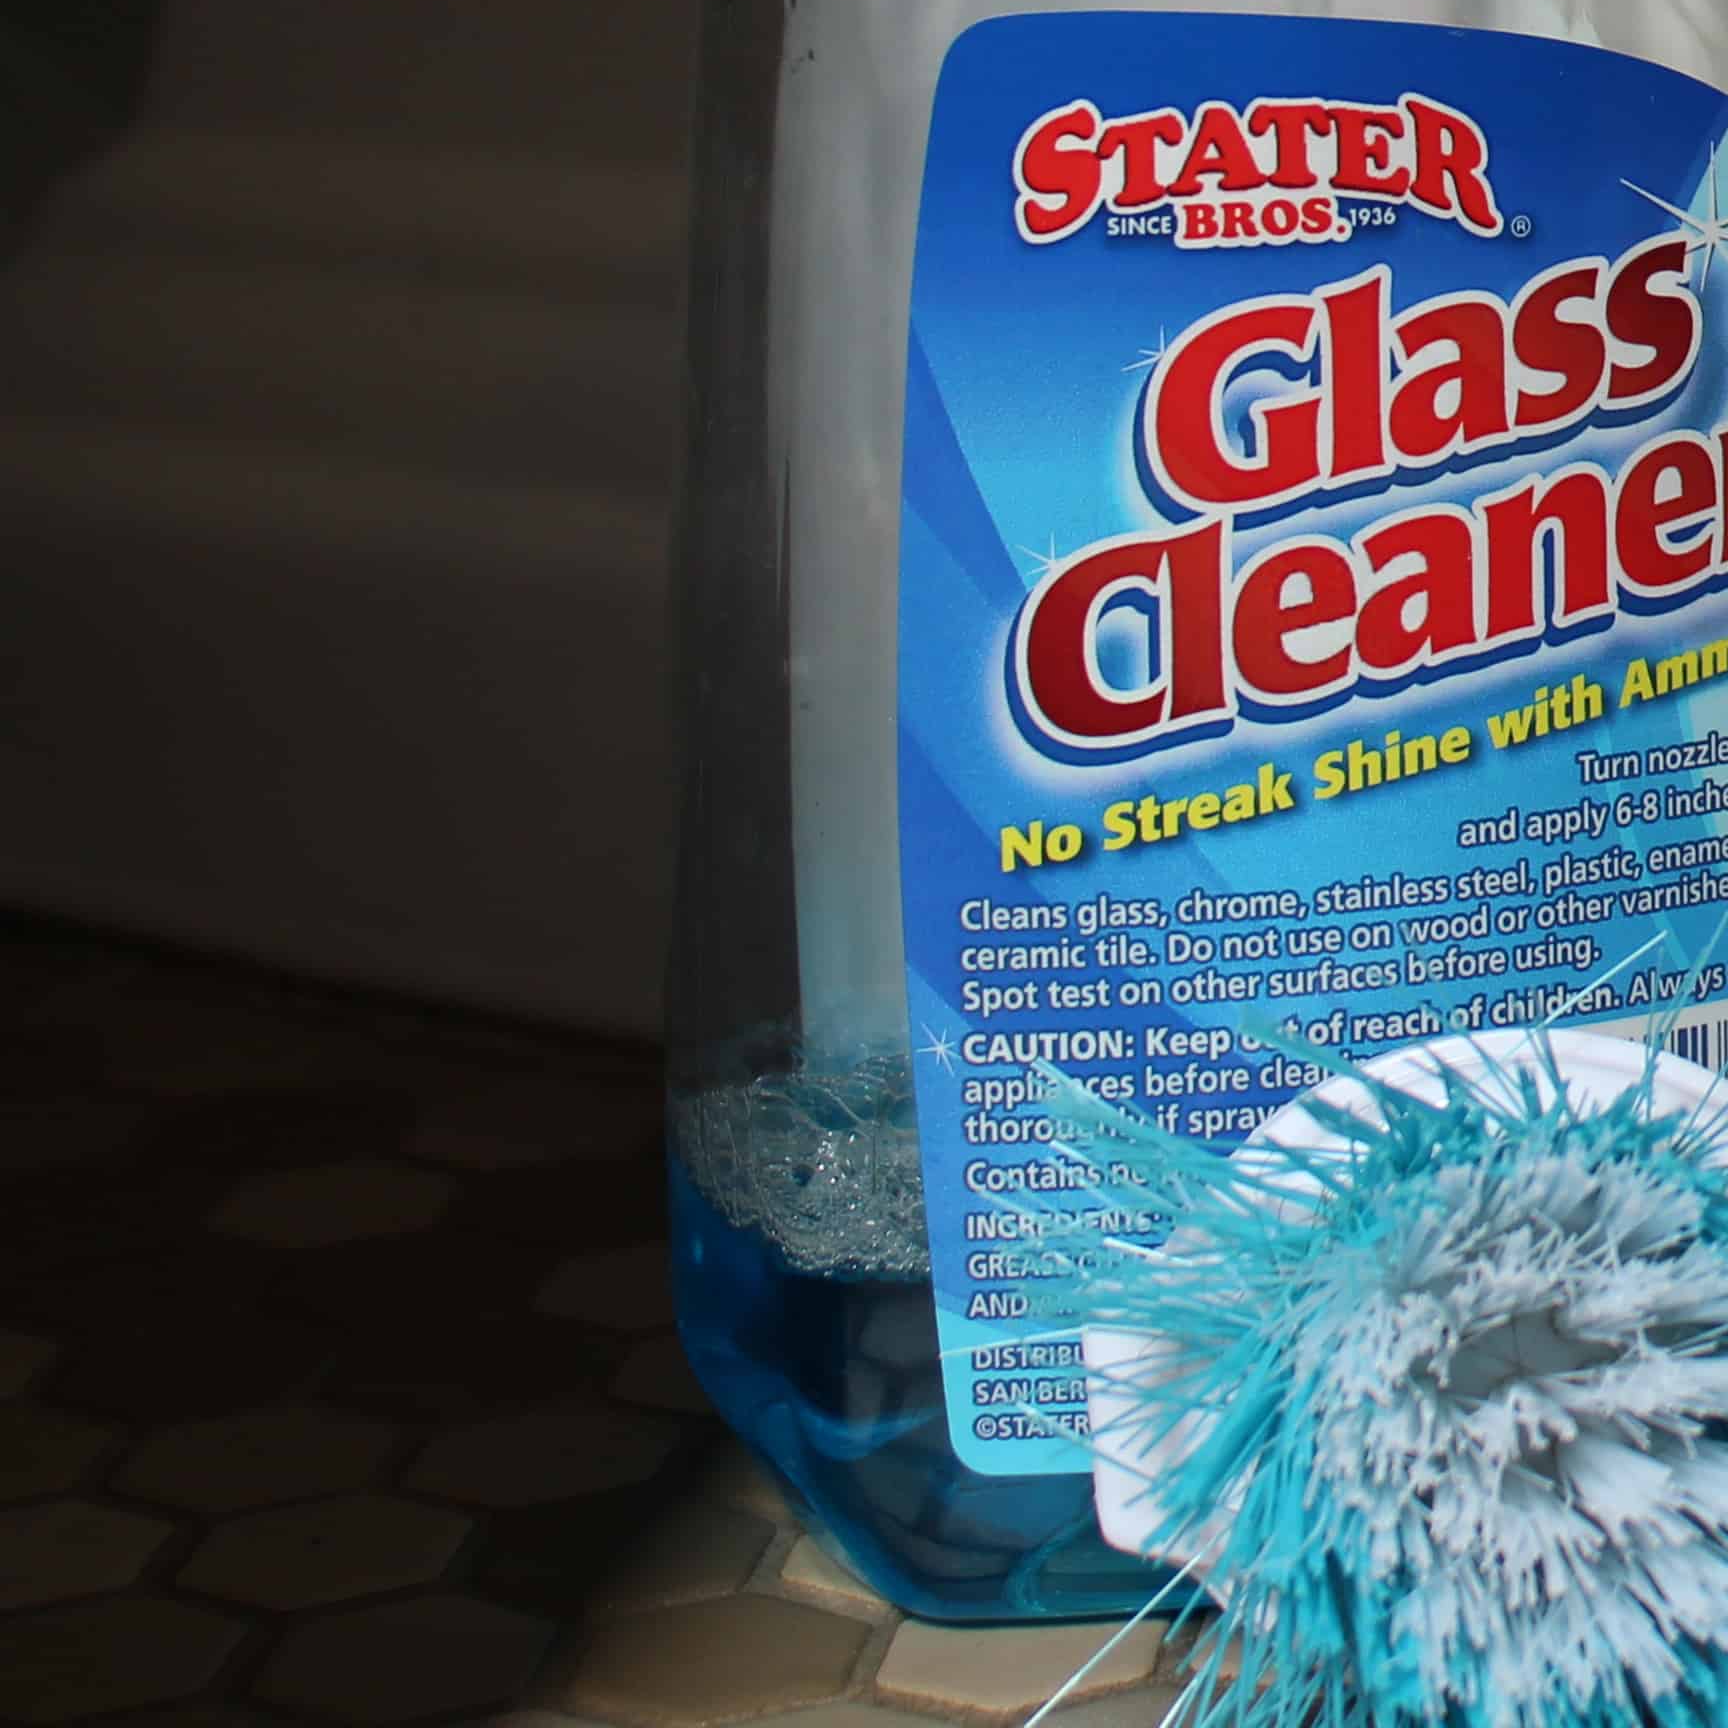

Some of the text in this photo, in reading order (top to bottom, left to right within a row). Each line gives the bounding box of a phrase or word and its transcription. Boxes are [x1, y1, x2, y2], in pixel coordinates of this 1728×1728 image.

[1016, 95, 1502, 242] STATER
[1107, 214, 1172, 238] SINCE
[1181, 196, 1351, 242] BROS.
[1349, 206, 1397, 228] 1936
[1152, 238, 1697, 507] Glass
[1000, 821, 1083, 873] No
[1103, 765, 1296, 852] Streak
[1314, 726, 1471, 801] Shine
[1486, 674, 1603, 750] with
[1578, 752, 1640, 783] Turn
[1459, 809, 1517, 847] and
[1526, 799, 1607, 843] apply
[1616, 791, 1660, 825] 6-8
[960, 899, 1068, 931] Cleans
[1077, 894, 1168, 935] glass,
[1178, 889, 1308, 921] chrome,
[1315, 875, 1449, 913] stainless
[1456, 861, 1536, 899] steel,
[1545, 848, 1641, 895] plastic,
[960, 937, 1087, 971] ceramic
[1095, 935, 1157, 967] tile.
[1168, 933, 1214, 963] Do
[1223, 930, 1279, 959] not
[1288, 927, 1342, 955] use
[1351, 924, 1391, 949] on
[1401, 905, 1488, 944] wood
[1497, 908, 1529, 934] or
[1536, 892, 1614, 928] other
[962, 937, 1601, 1018] Spot test on other surfaces before using.
[962, 1031, 1136, 1064] CAUTION:
[1146, 1026, 1232, 1062] Keep
[1307, 1011, 1345, 1046] of
[1353, 1003, 1440, 1041] reach
[1449, 995, 1486, 1027] of
[1491, 984, 1621, 1024] children.
[1145, 1062, 1250, 1097] before
[1155, 1103, 1180, 1135] if
[965, 1159, 1103, 1192] Contains
[968, 1291, 1030, 1319] AND
[975, 1381, 1029, 1405] SAN
